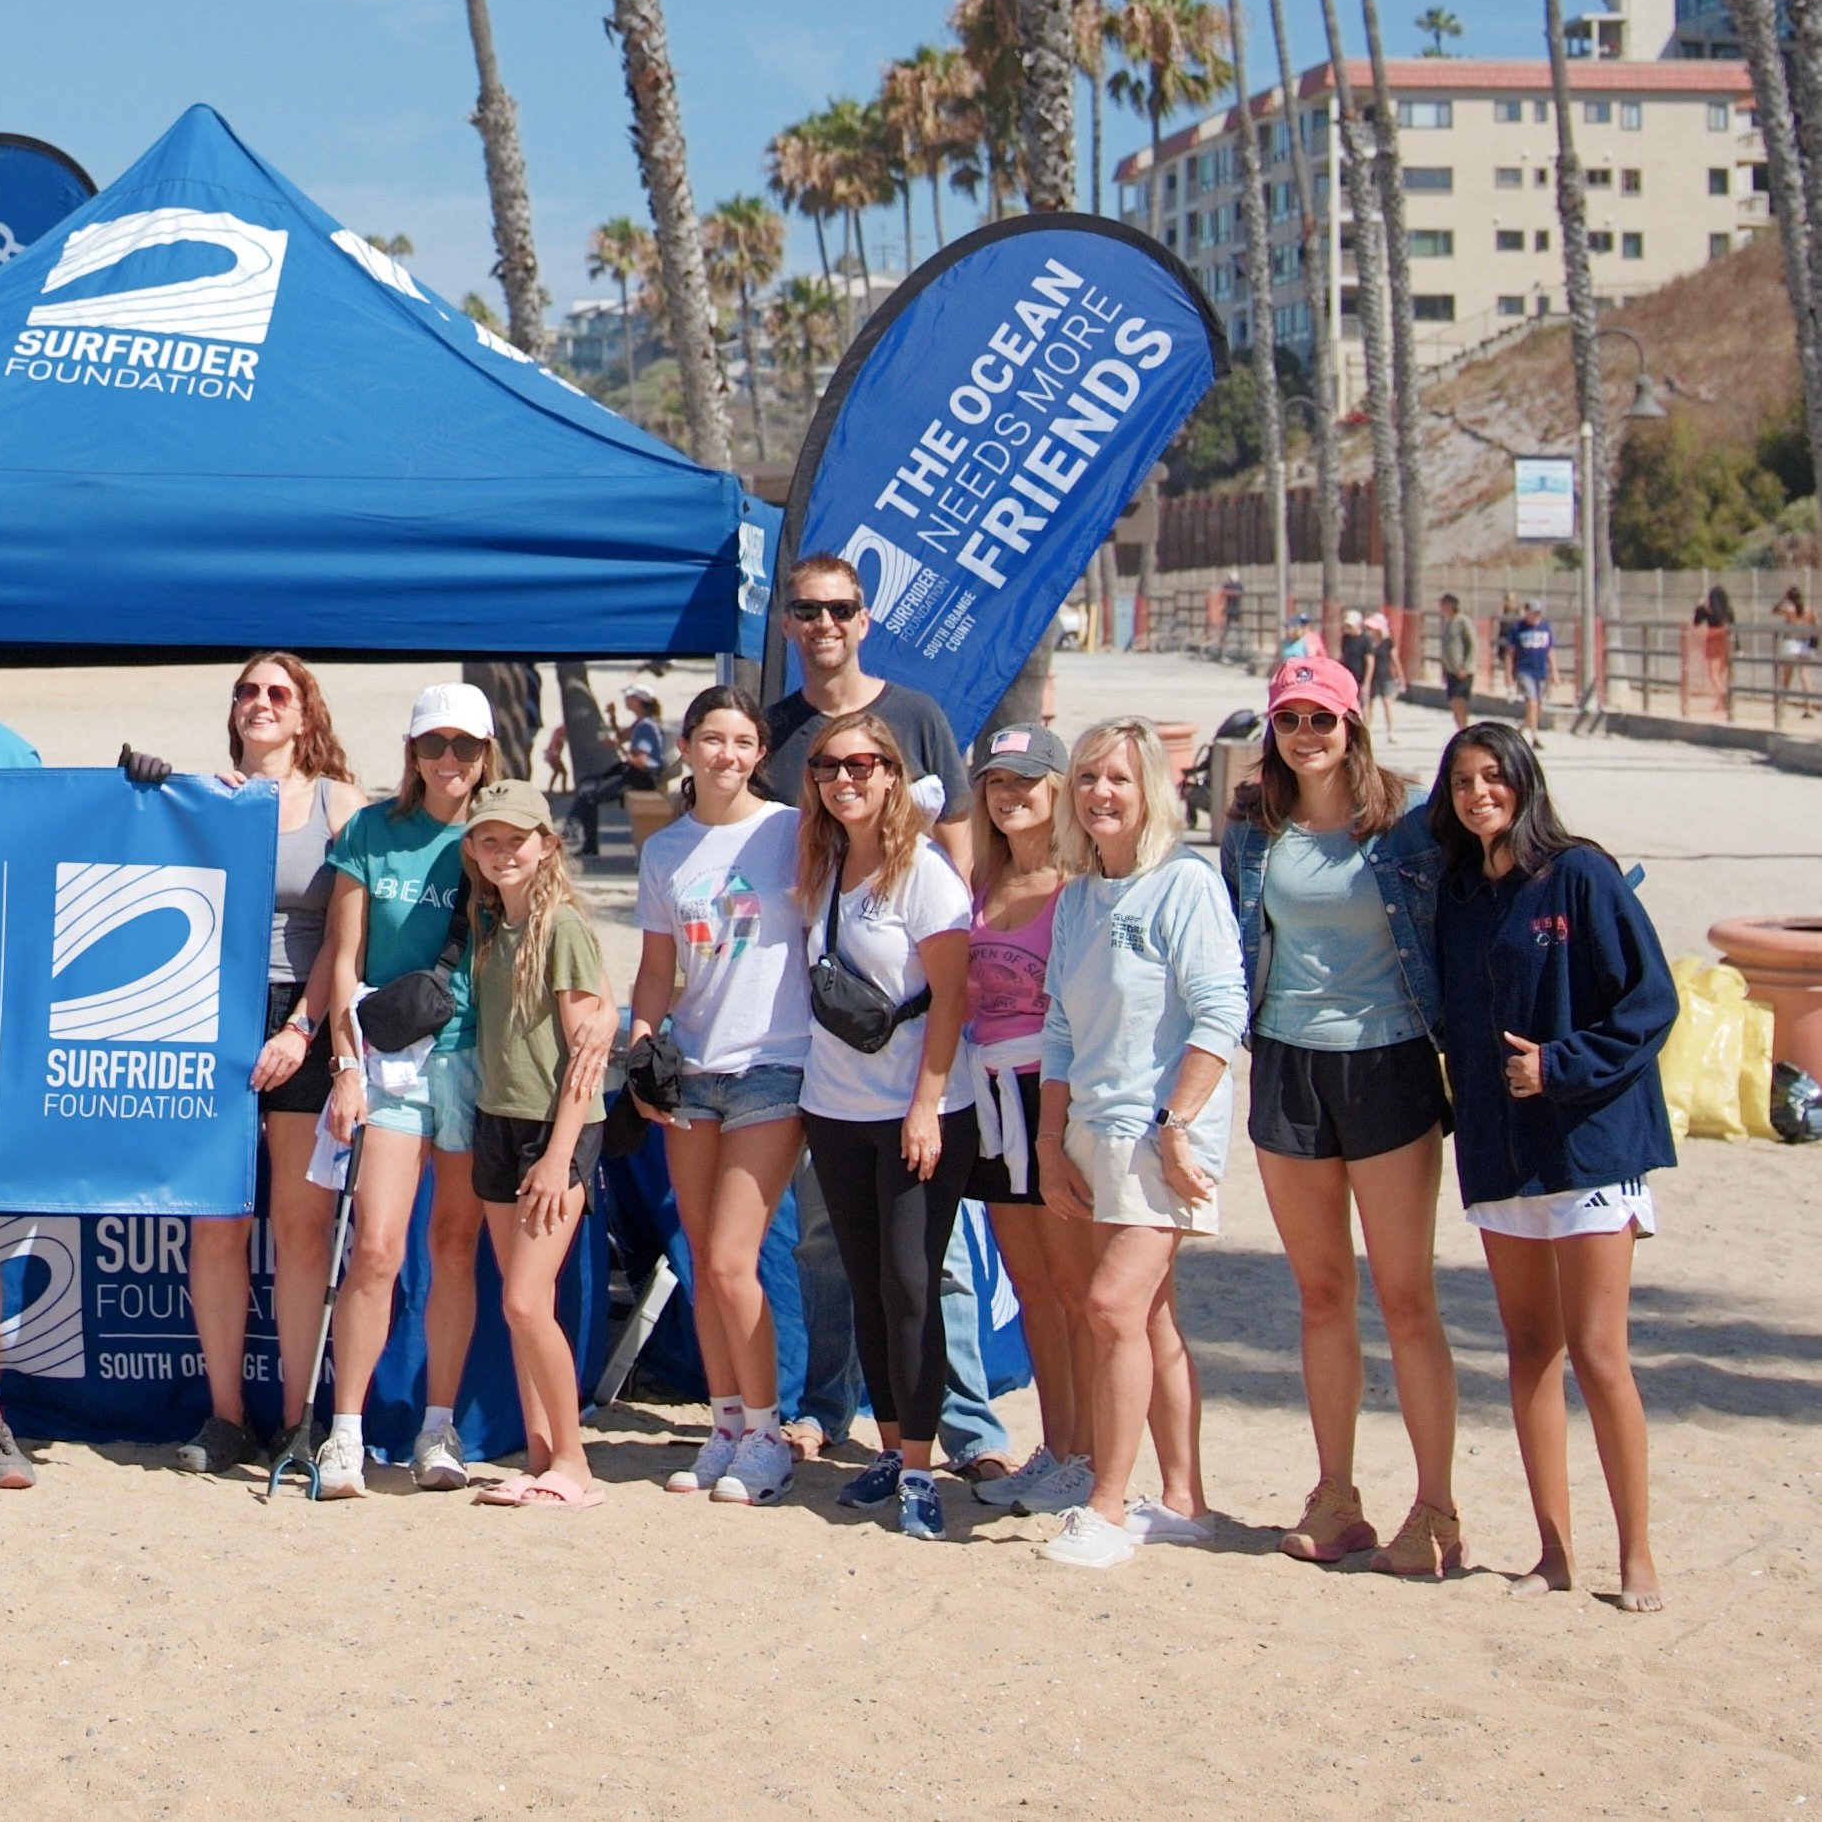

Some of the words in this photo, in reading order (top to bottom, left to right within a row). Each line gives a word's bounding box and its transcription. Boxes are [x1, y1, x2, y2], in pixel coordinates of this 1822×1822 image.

[4, 357, 255, 402] FOUNDATION
[13, 329, 260, 380] SURFRIDER
[874, 419, 969, 519] THE
[949, 257, 1085, 425] OCEAN
[916, 412, 1031, 554] NEEDS
[1016, 285, 1123, 414] MORE
[955, 316, 1173, 590] FRIENDS
[885, 567, 940, 635] SURFRIDER
[899, 576, 951, 643] FOUNDATION
[922, 626, 951, 660] SOUTH
[944, 589, 977, 630] ORANGE
[945, 612, 976, 653] COUNTY
[374, 877, 459, 910] BEAC
[46, 1048, 216, 1090] SURFRIDER
[98, 1352, 173, 1380] SOUTH
[181, 1353, 270, 1382] ORGE
